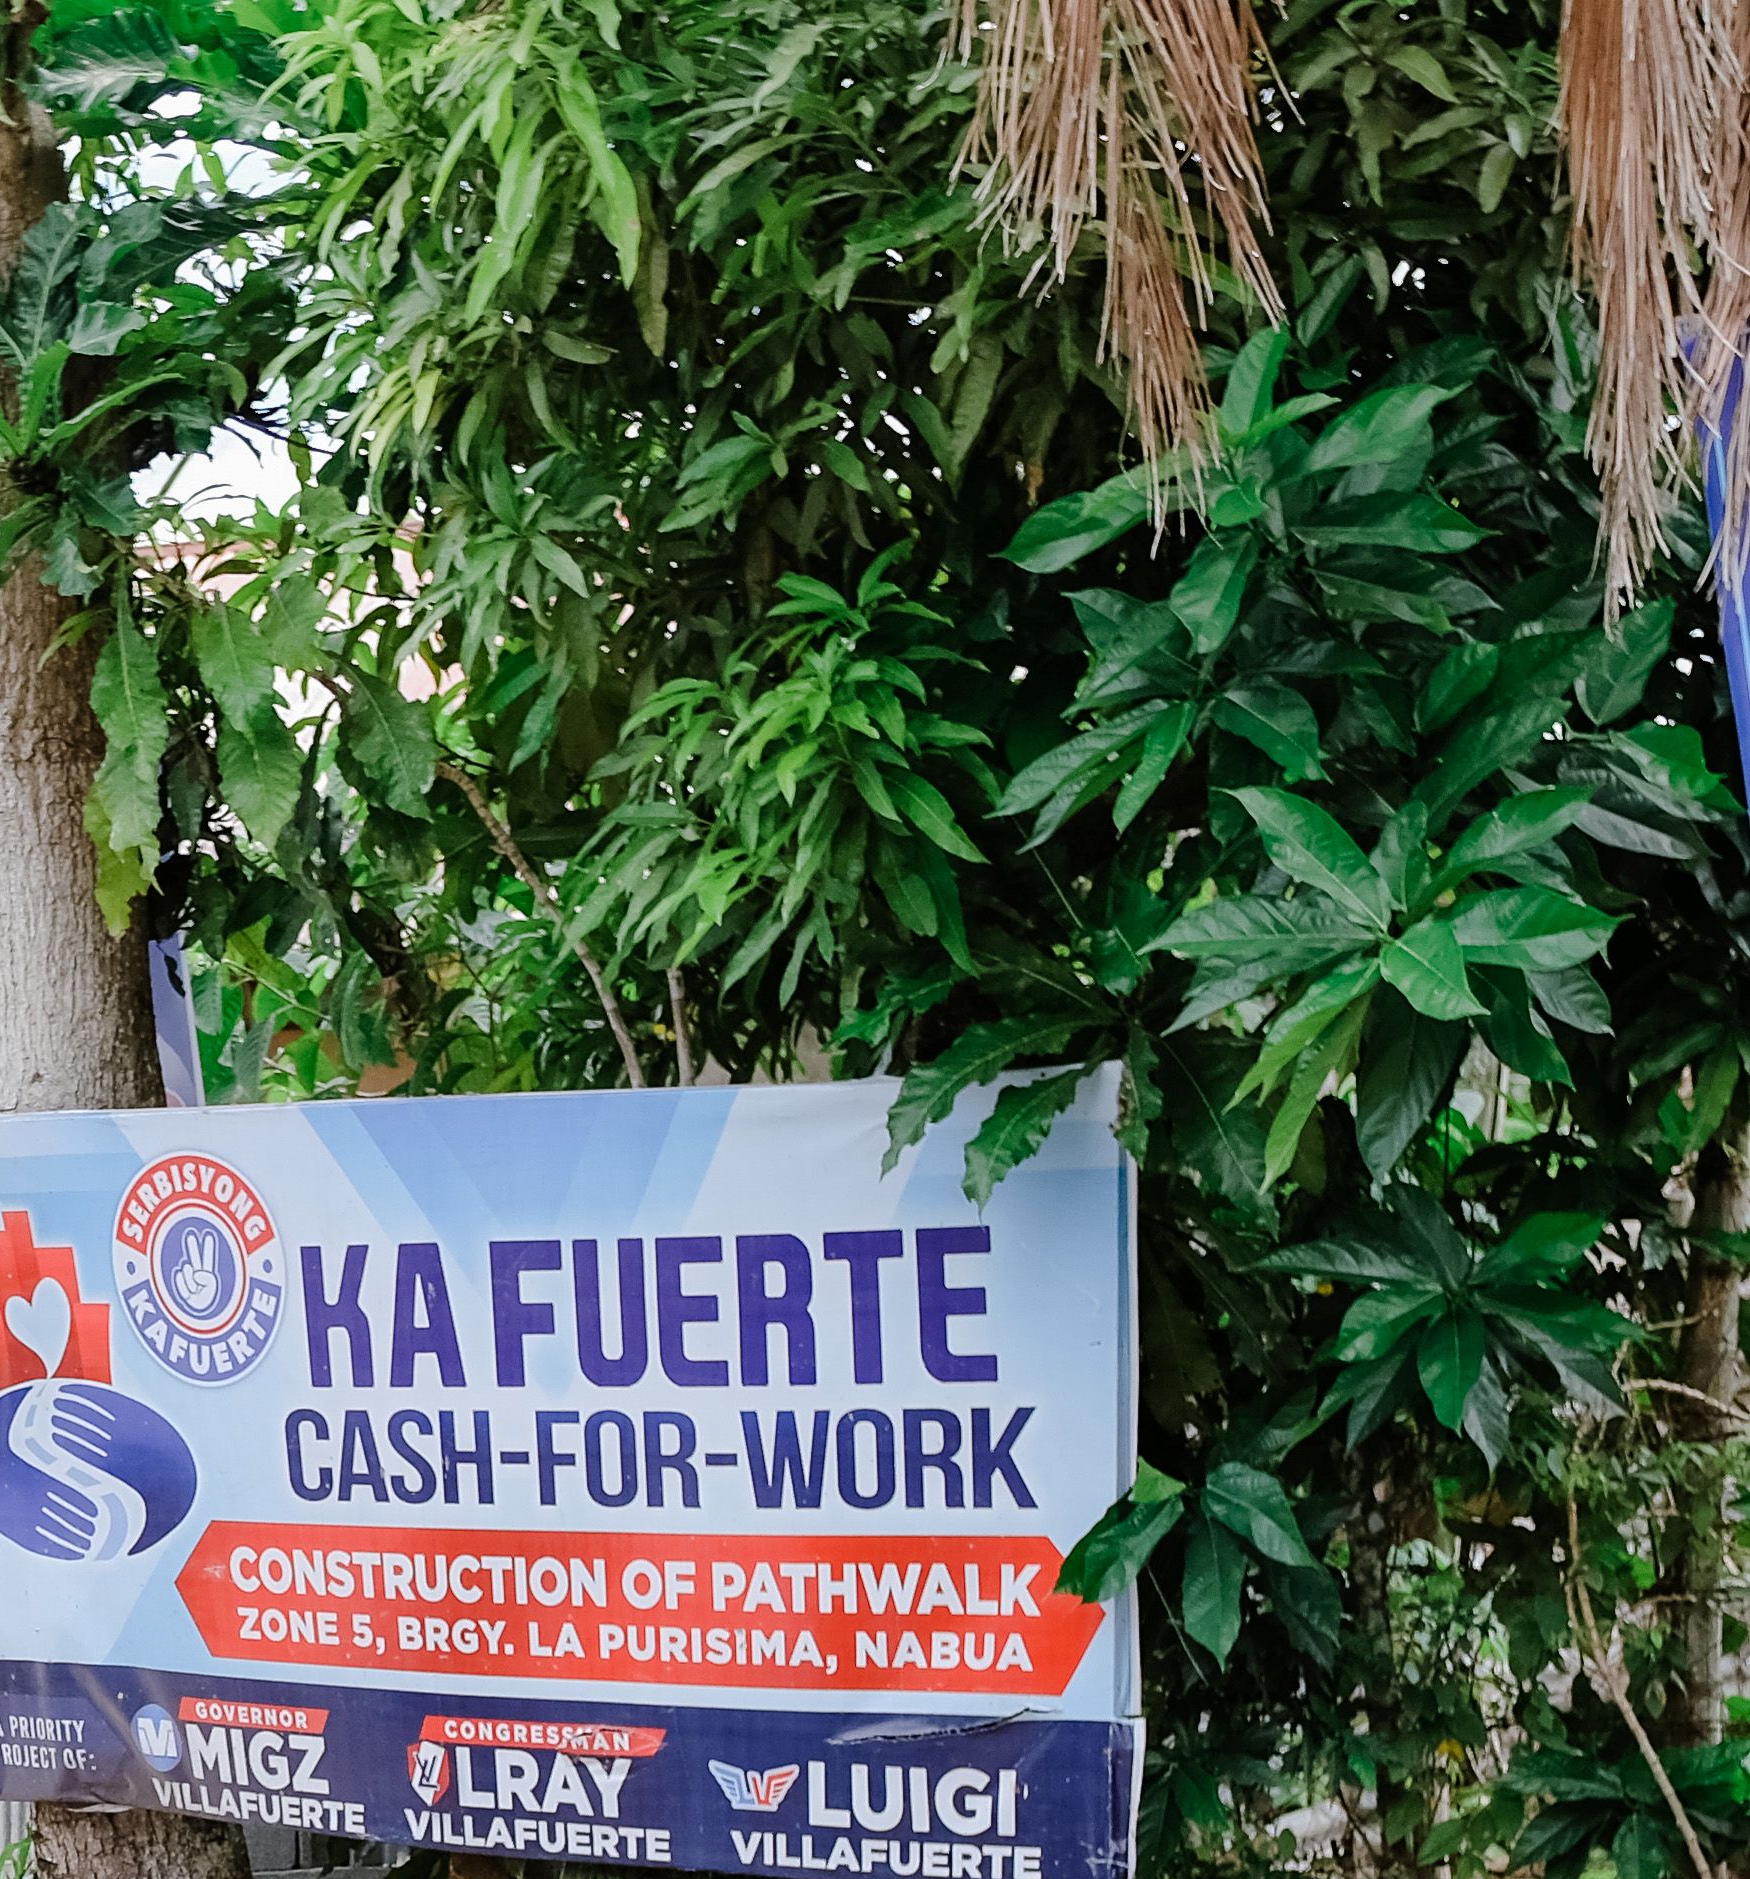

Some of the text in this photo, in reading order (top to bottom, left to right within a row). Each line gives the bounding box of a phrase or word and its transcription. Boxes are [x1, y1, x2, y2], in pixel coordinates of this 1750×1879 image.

[122, 1162, 267, 1244] SERBISYONG
[300, 1226, 999, 1388] KA FUERTE
[285, 1406, 1039, 1510] CASH-FOR-WORK
[229, 1545, 1043, 1618] CONSTRUCTION OF PATHWALK
[236, 1607, 1035, 1676] ZONE 5, BRGY. LA PURISIMA, NABUA
[8, 1715, 86, 1744] PRIORITY
[194, 1701, 309, 1730] GOVERNOR
[63, 1747, 98, 1772] OF:
[185, 1723, 331, 1796] MIGZ
[454, 1745, 633, 1819] LRAY
[151, 1776, 367, 1835] VILLAFUERTE
[403, 1808, 673, 1863] VILLAFUERTE
[807, 1760, 1018, 1838] LUIGI
